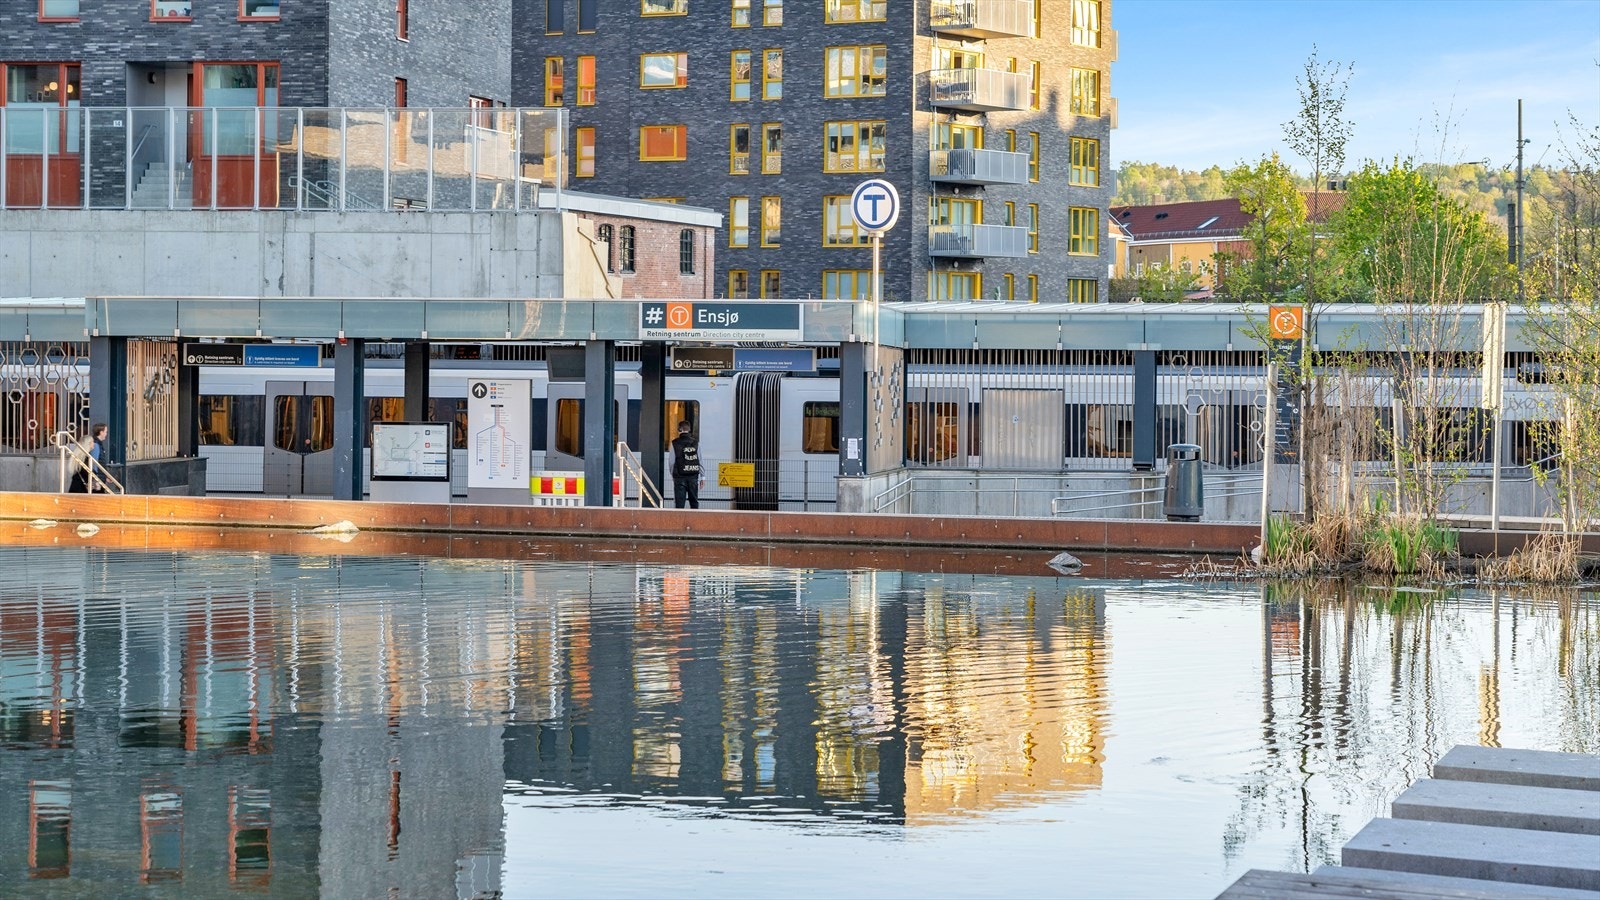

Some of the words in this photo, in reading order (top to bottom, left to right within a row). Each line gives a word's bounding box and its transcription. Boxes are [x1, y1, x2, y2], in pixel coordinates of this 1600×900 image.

[863, 194, 886, 222] T
[674, 310, 685, 325] T
[698, 309, 739, 327] Ensjø
[646, 330, 671, 338] Retning
[732, 331, 744, 339] city
